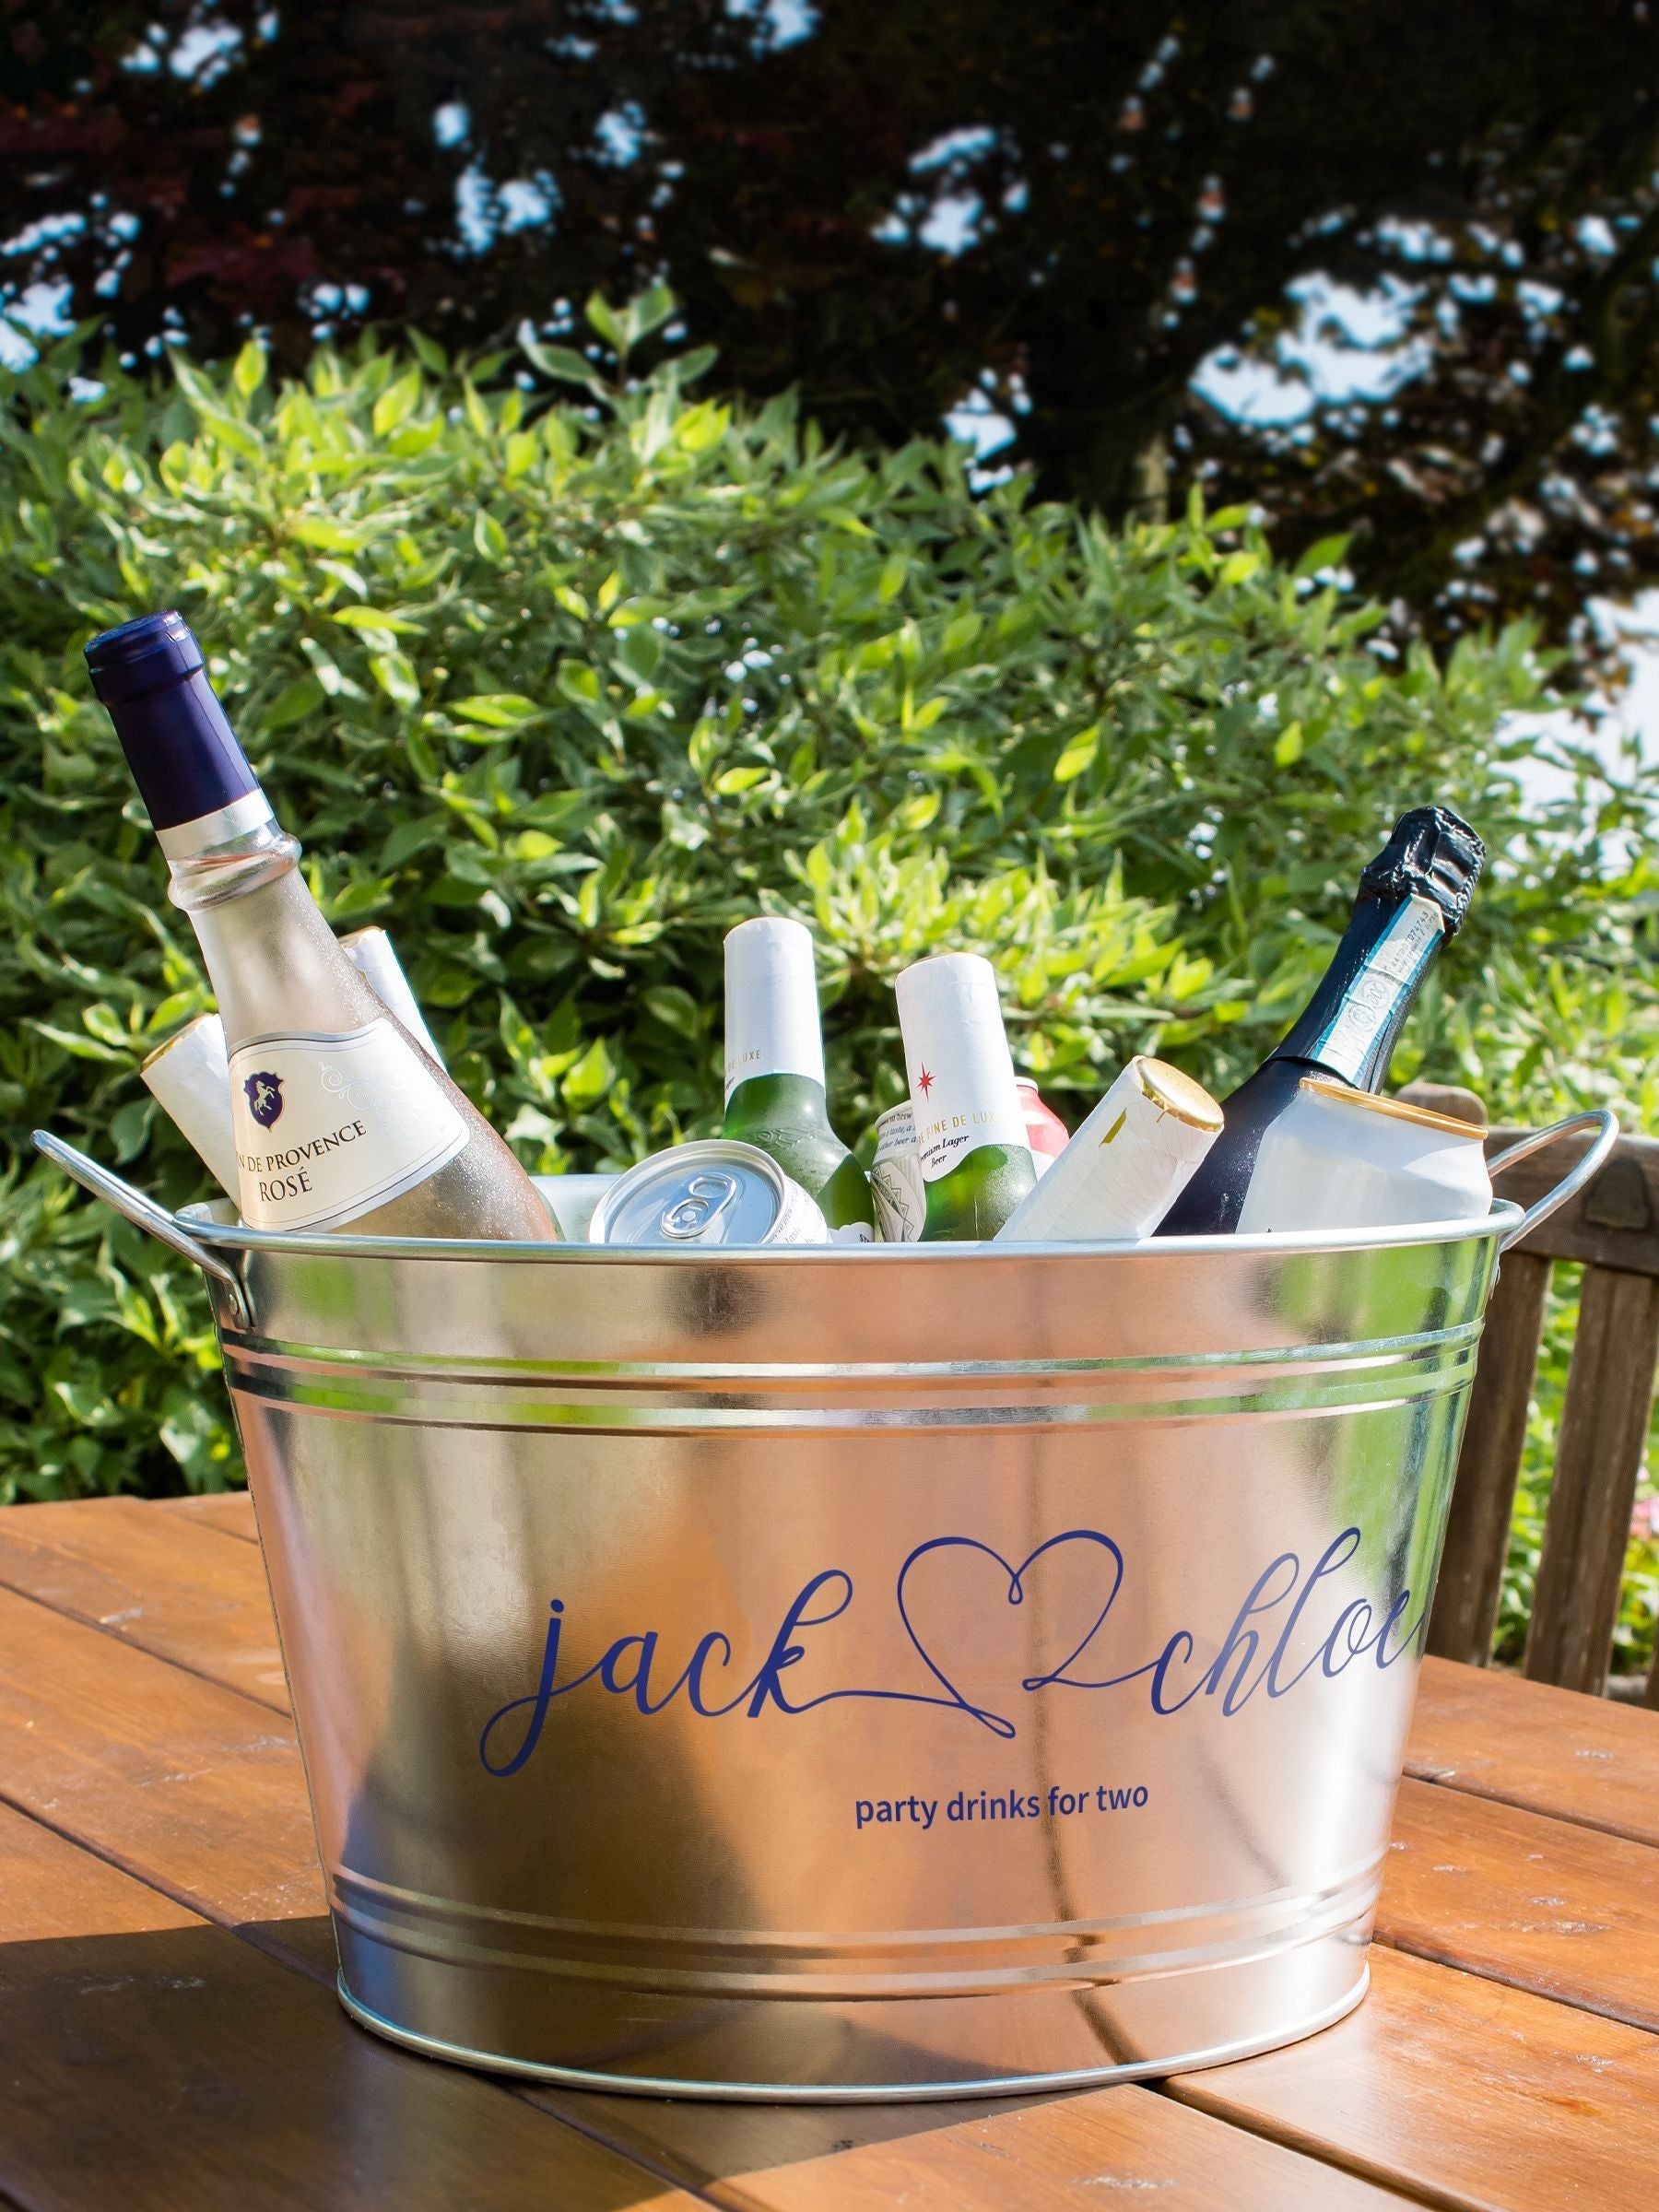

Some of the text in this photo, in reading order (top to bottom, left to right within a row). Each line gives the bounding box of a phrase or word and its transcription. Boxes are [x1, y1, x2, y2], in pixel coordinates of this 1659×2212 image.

[926, 1119, 947, 1139] FINE
[952, 1114, 967, 1127] DE
[971, 1112, 996, 1124] LUX
[942, 1135, 970, 1148] Lager
[247, 1156, 264, 1172] DE
[265, 1120, 367, 1171] PROVENCE
[931, 1153, 947, 1169] Beer
[258, 1165, 313, 1203] ROSÉ
[479, 1526, 1426, 1777] jack chloe
[855, 1785, 1149, 1830] party drinks for two
